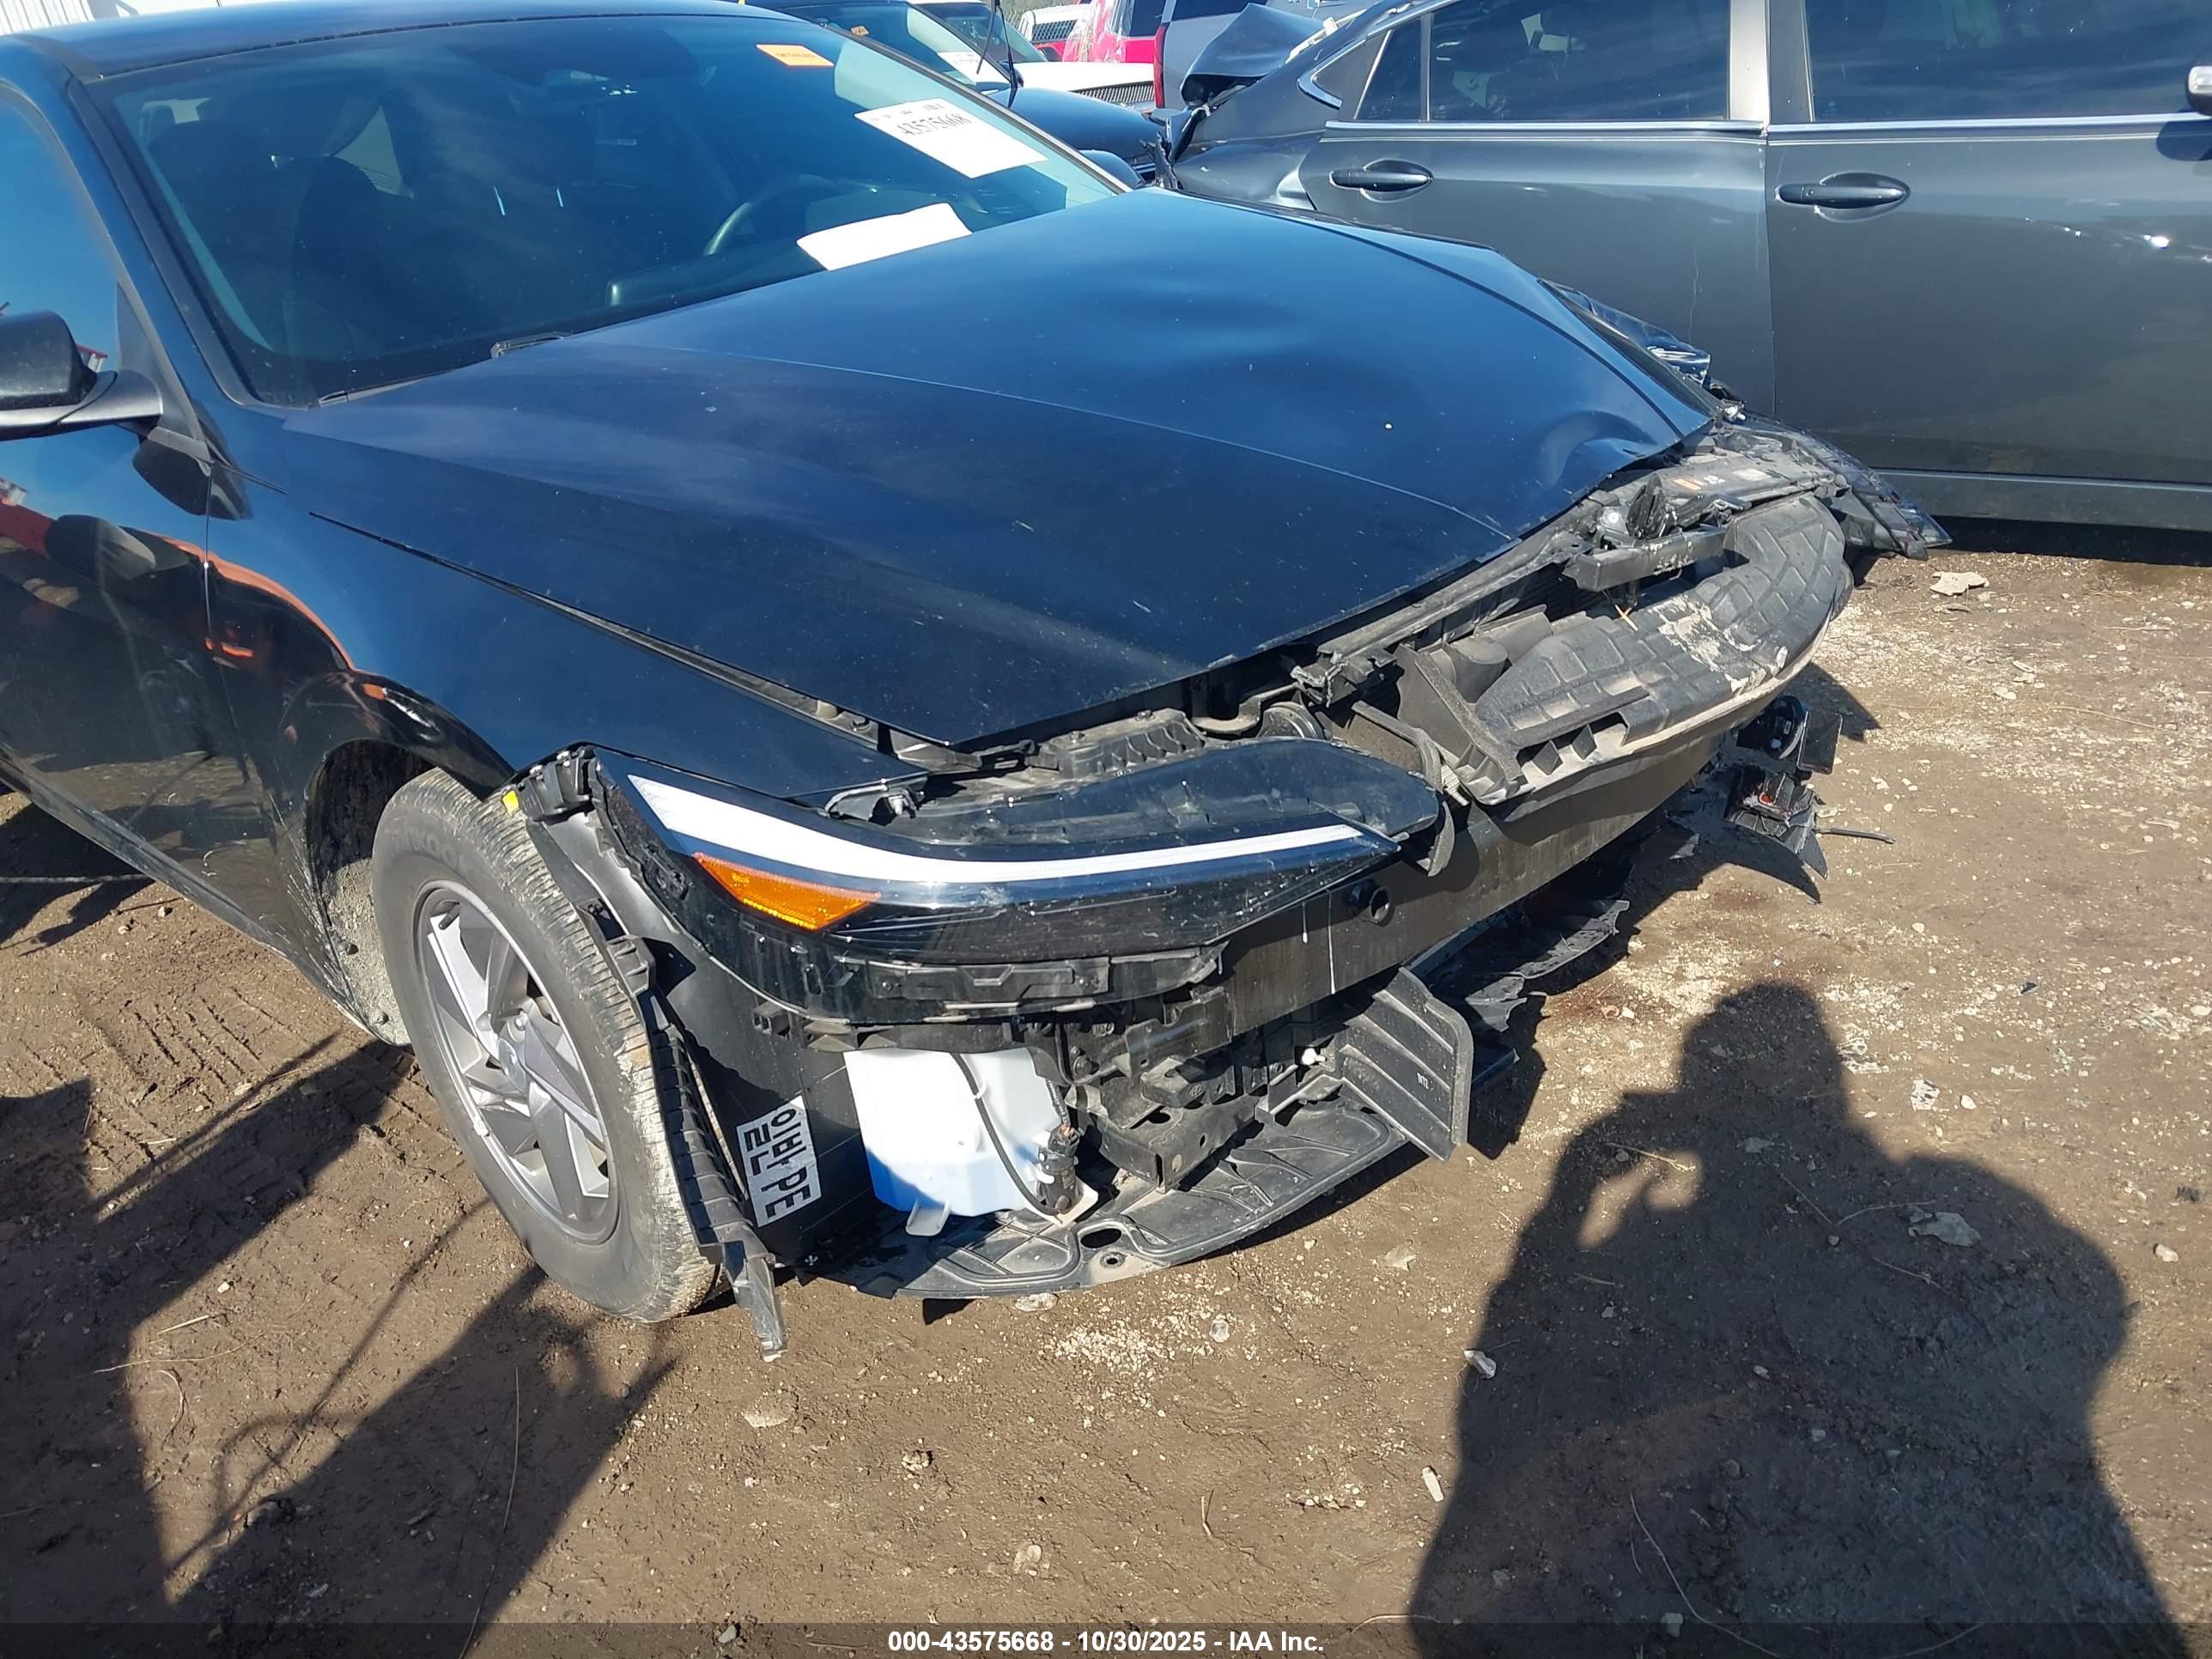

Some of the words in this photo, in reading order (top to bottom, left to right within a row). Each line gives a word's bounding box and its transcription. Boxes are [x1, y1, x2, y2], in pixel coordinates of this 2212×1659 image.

[897, 112, 971, 136] 43575668
[744, 1108, 807, 1176] 일반
[761, 1167, 811, 1219] PE
